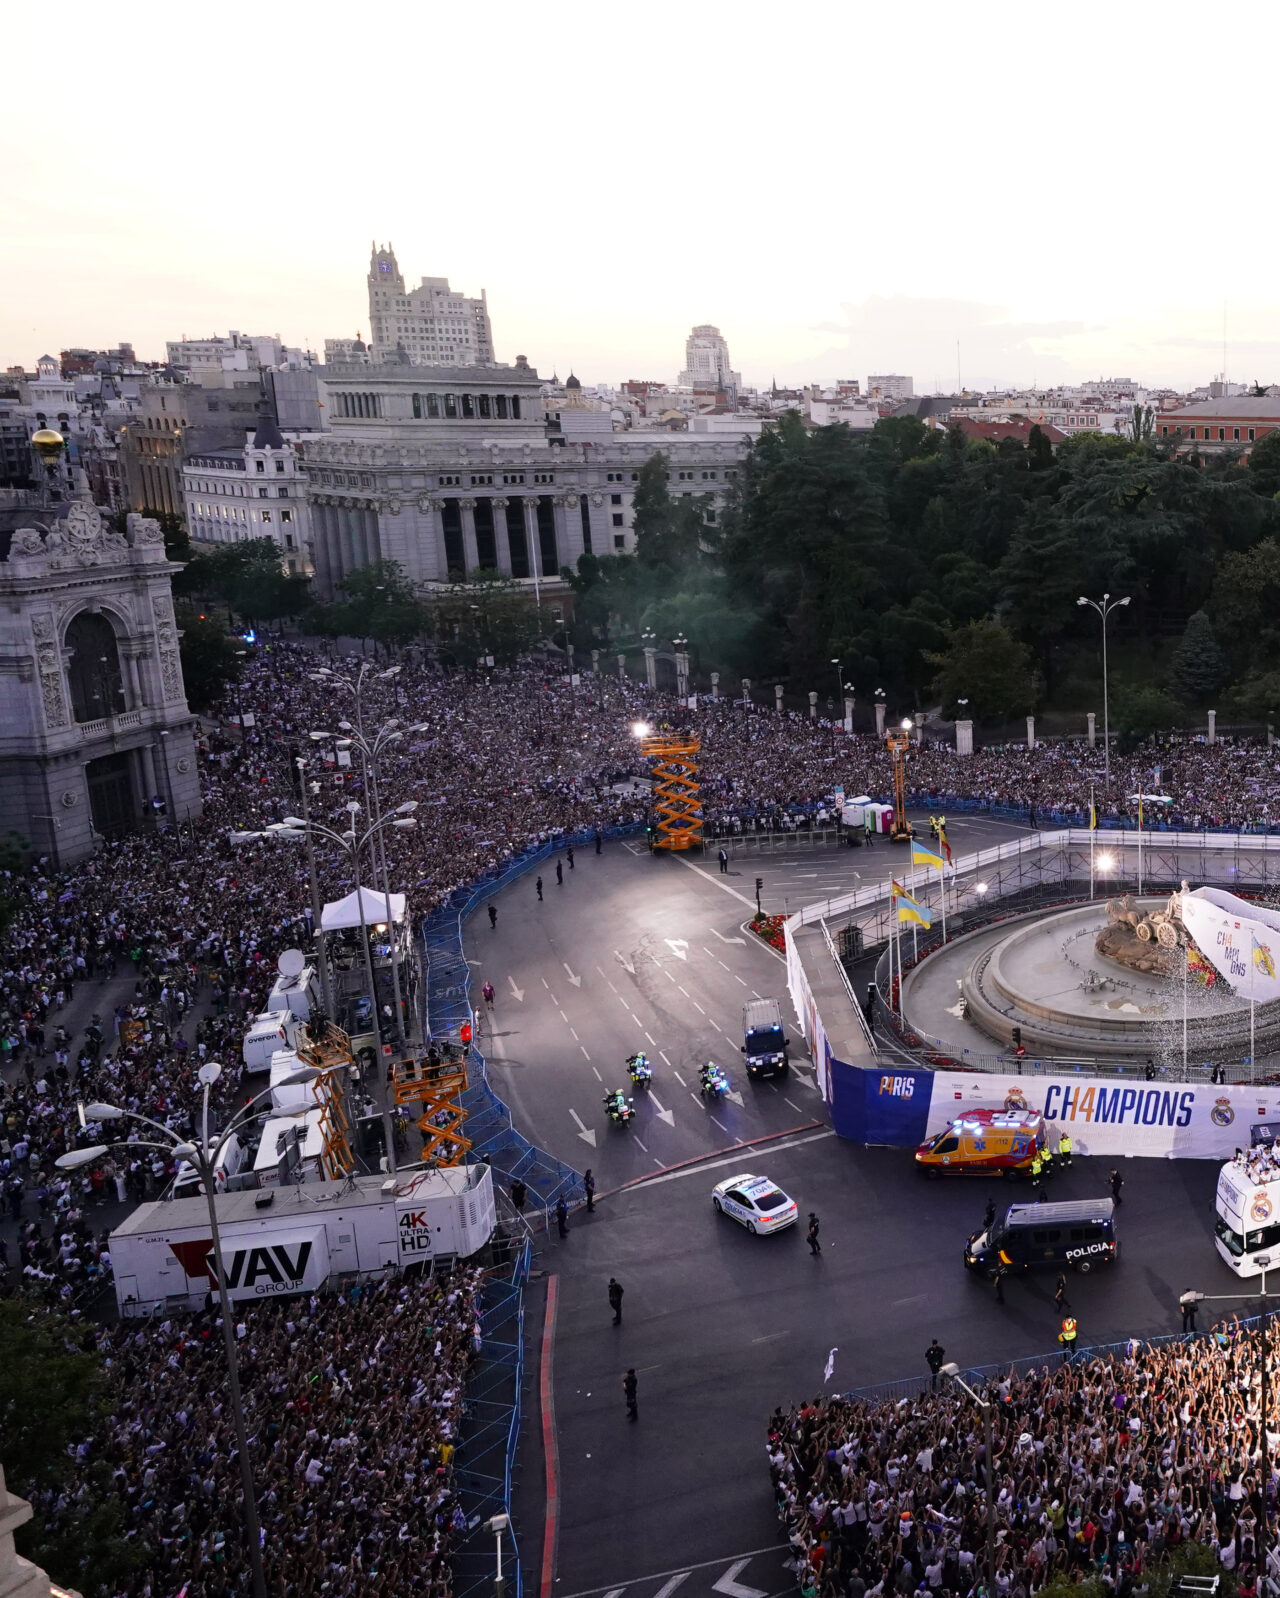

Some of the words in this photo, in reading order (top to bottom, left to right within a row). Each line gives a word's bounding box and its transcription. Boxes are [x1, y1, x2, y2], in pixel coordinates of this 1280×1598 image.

[248, 1034, 277, 1044] overon
[399, 1211, 429, 1229] 4K
[400, 1228, 431, 1238] ULTRA
[401, 1235, 431, 1251] HD
[255, 1280, 304, 1295] GROUP
